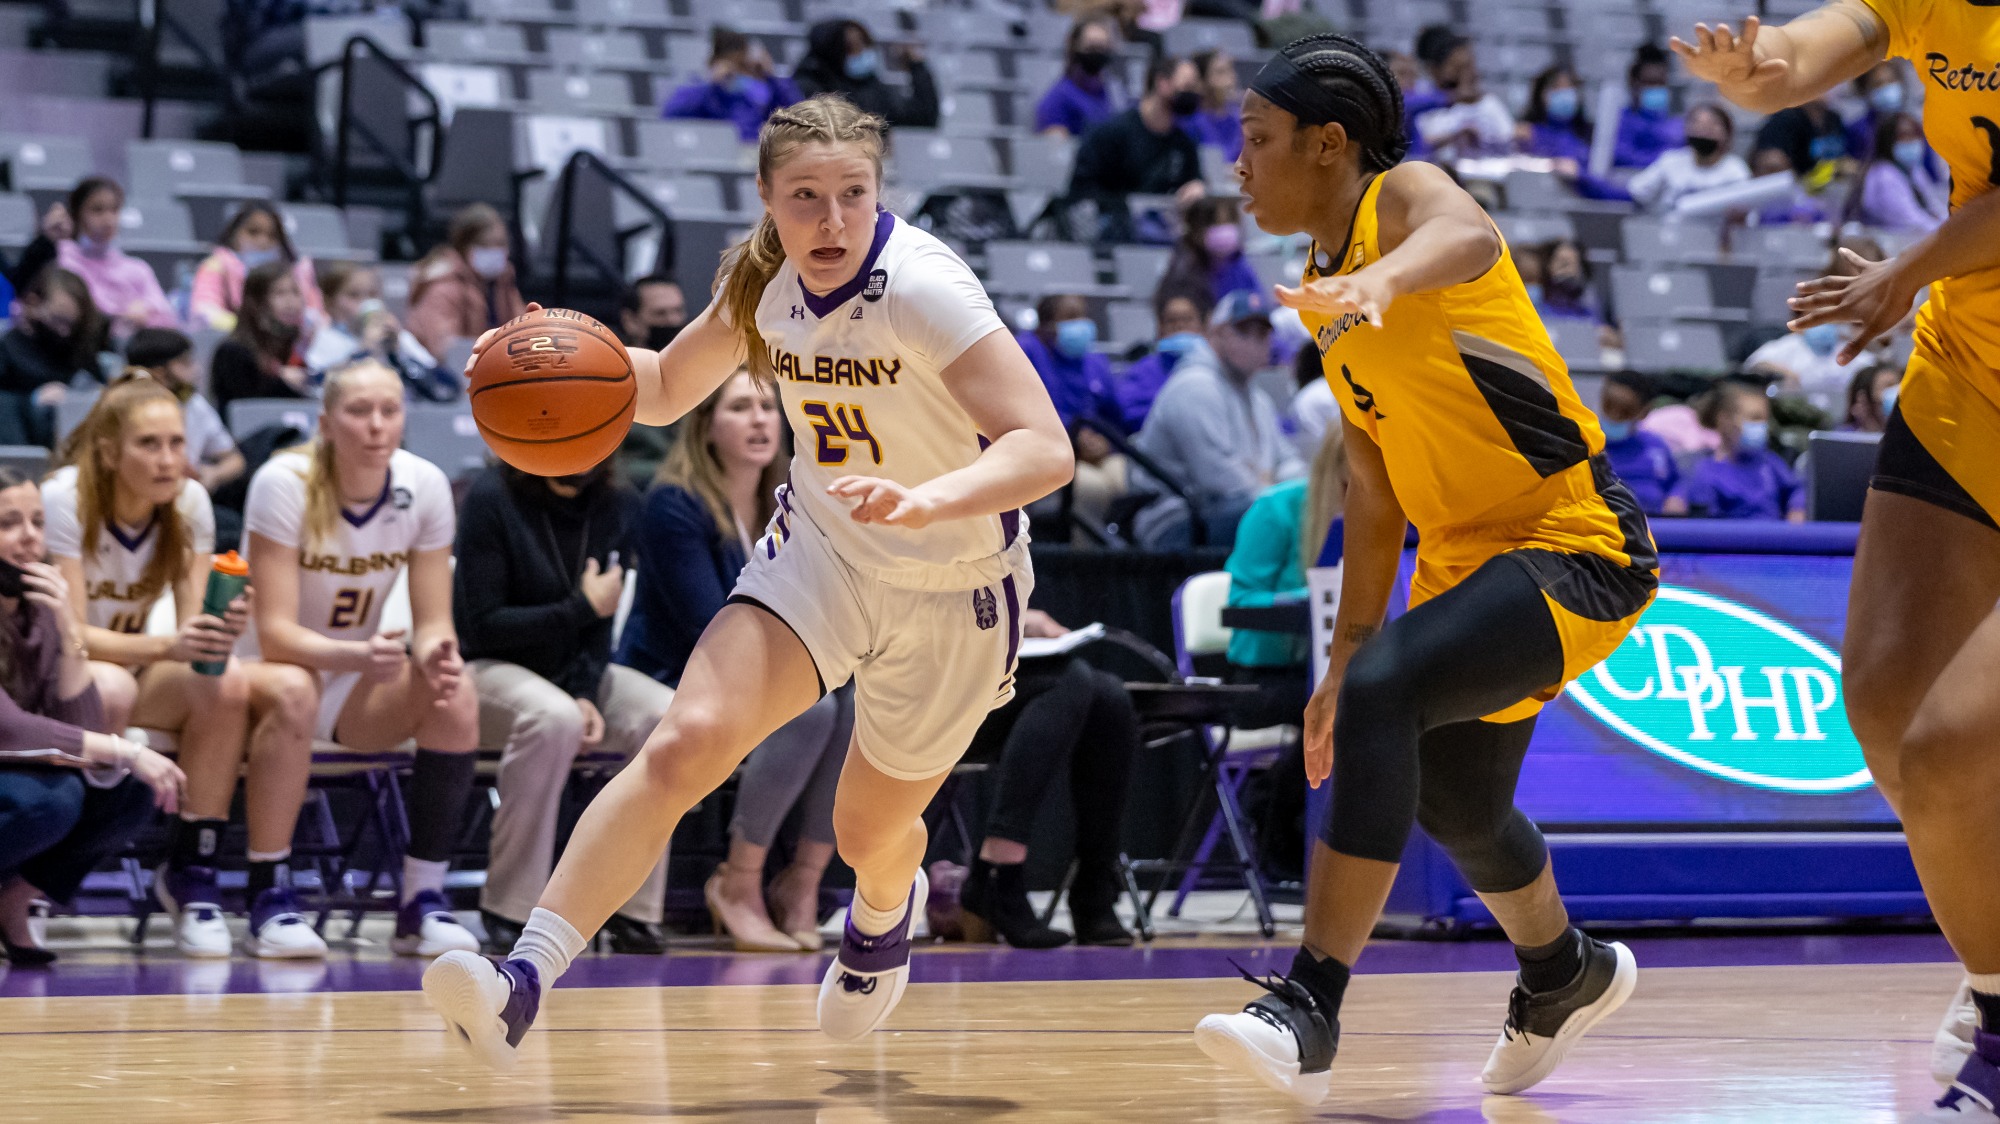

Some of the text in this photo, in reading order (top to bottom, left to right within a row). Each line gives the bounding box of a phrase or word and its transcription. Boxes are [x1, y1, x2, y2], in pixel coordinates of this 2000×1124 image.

[800, 399, 883, 467] 24
[328, 587, 374, 629] 21
[1594, 624, 1837, 741] CDPHP
